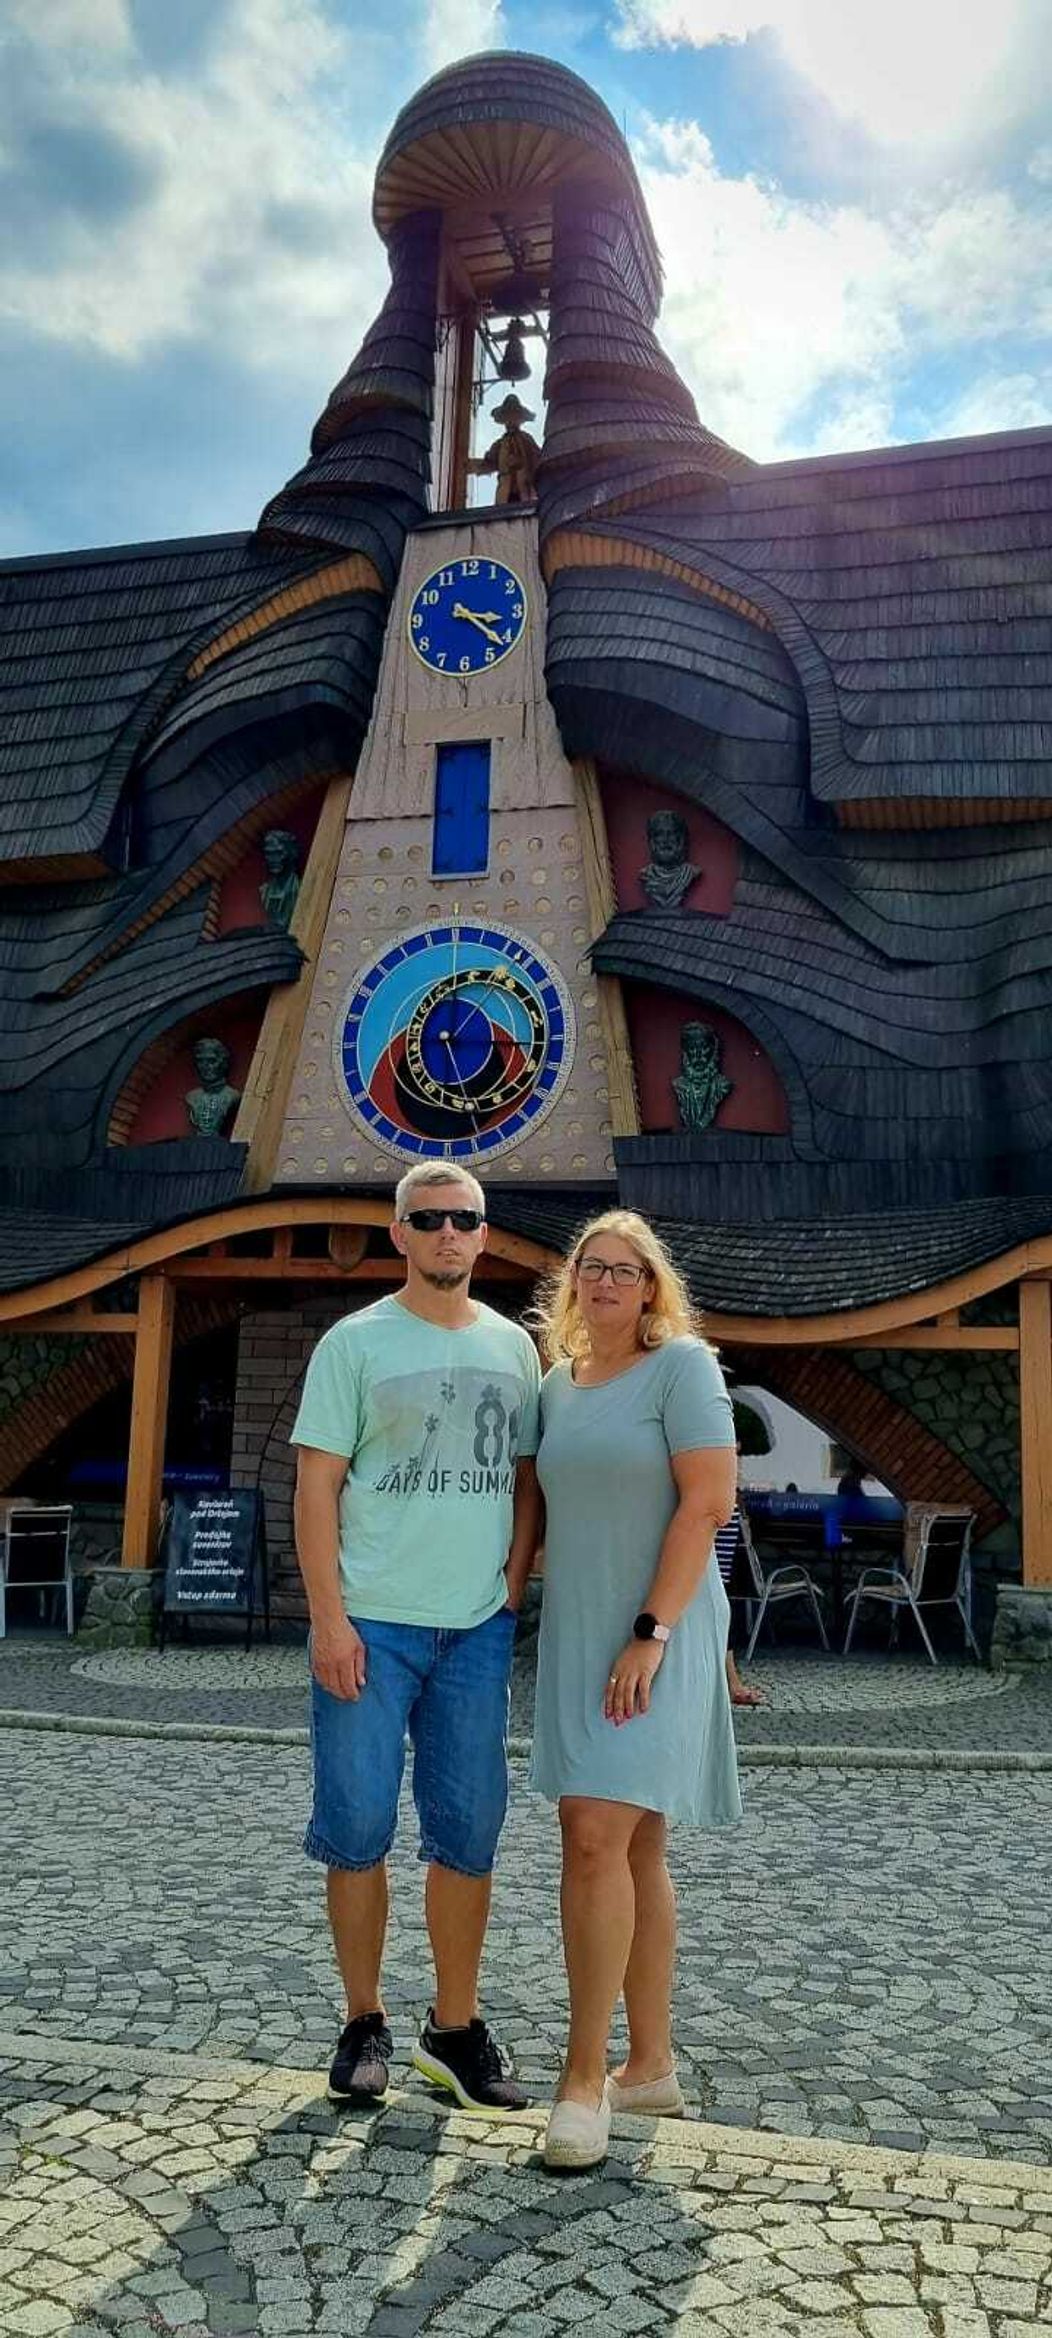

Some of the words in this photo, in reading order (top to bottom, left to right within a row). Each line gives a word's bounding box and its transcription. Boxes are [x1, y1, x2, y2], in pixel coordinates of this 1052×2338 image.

[461, 560, 479, 576] 12
[489, 565, 497, 580] 1
[439, 572, 454, 586] 11
[505, 580, 515, 595] 2
[422, 590, 439, 605] 10
[512, 604, 522, 619] 3
[412, 614, 423, 629] 9
[502, 628, 511, 643] 4
[419, 636, 430, 652] 8
[437, 653, 447, 668] 7
[485, 647, 495, 662] 5
[459, 656, 470, 671] 6
[428, 1470, 452, 1493] OF
[189, 1509, 207, 1519] pod
[176, 1590, 203, 1601] Vstup
[203, 1589, 237, 1600] zdarma
